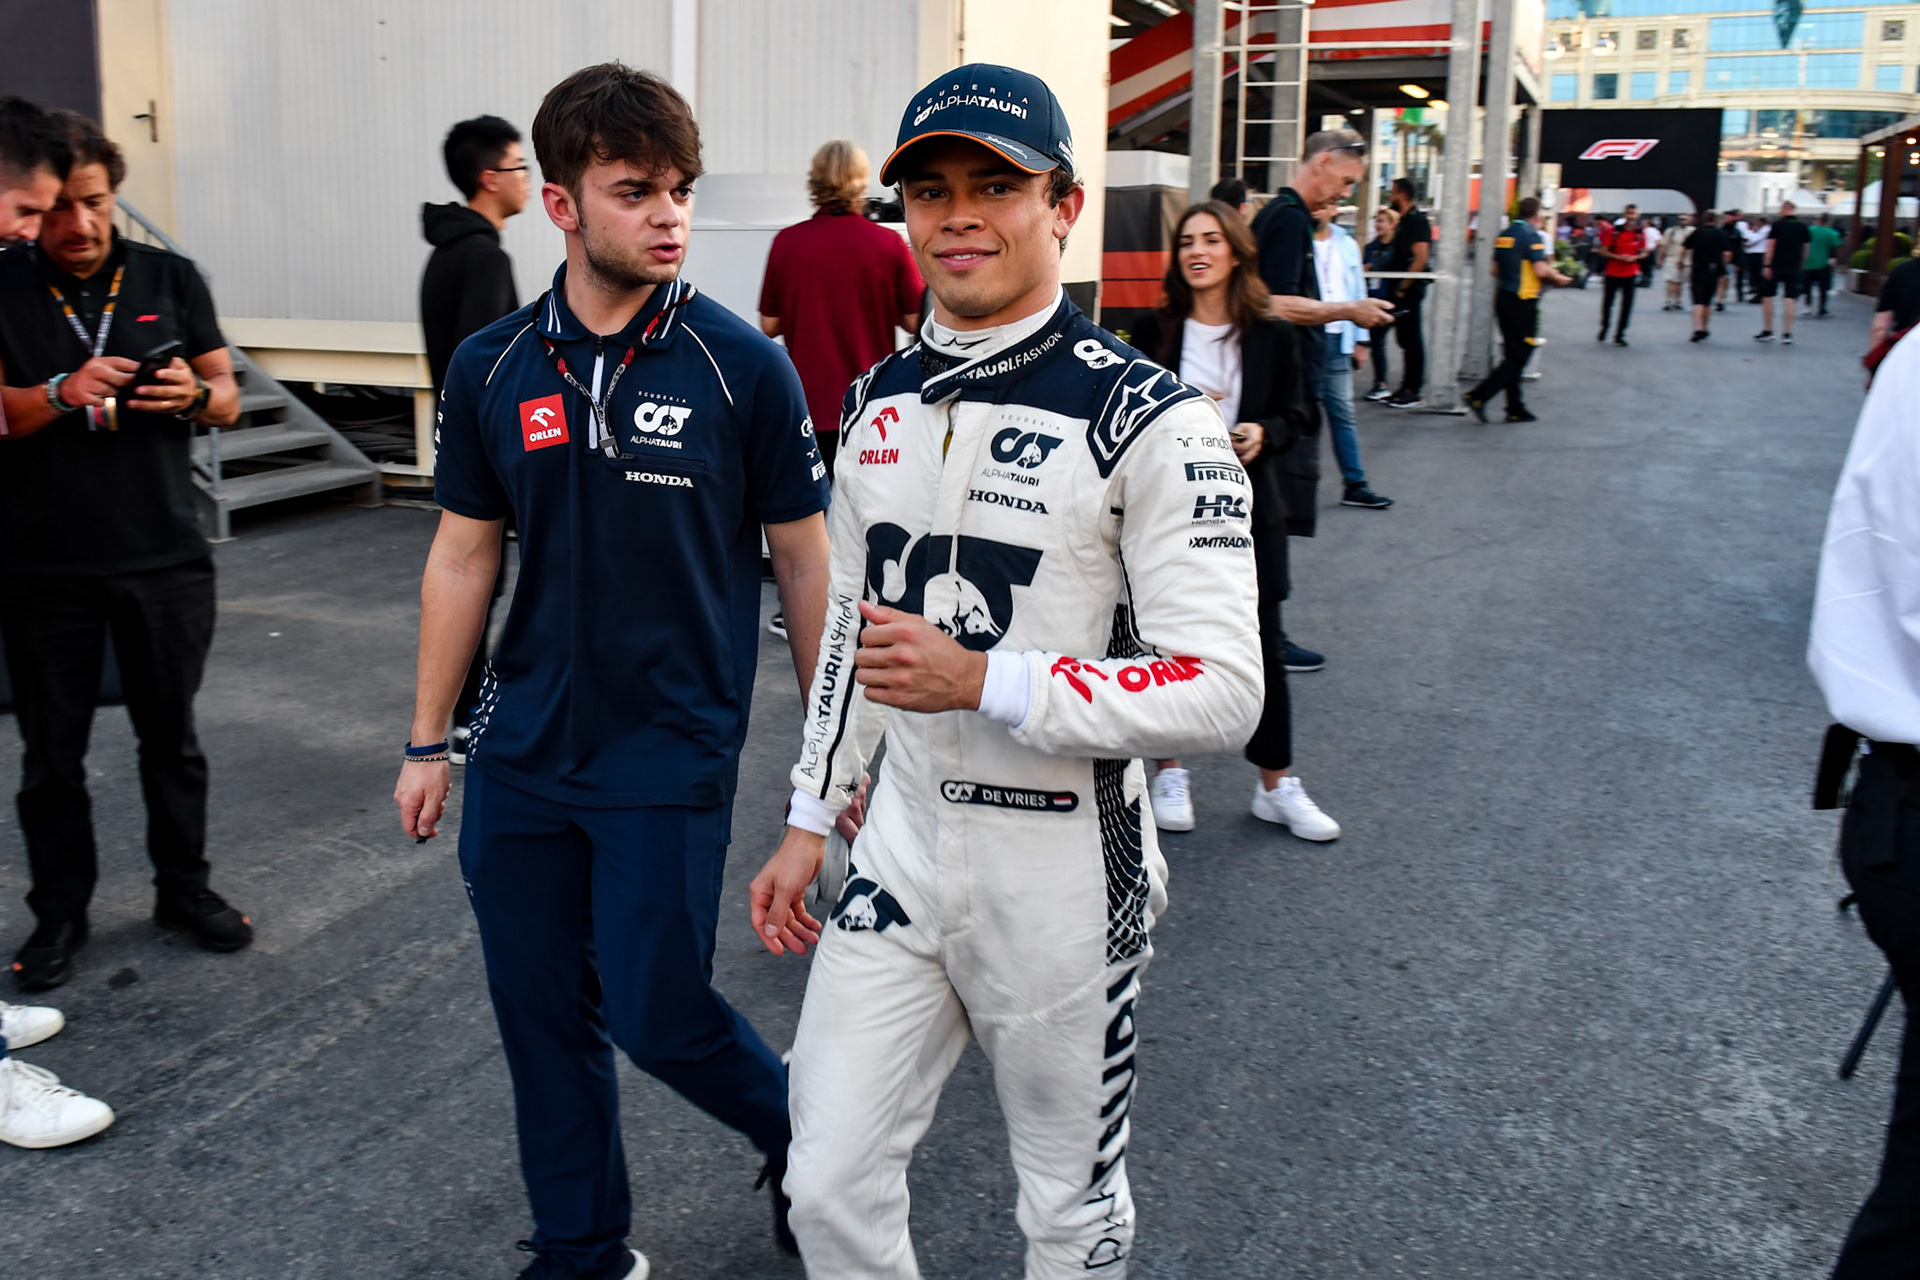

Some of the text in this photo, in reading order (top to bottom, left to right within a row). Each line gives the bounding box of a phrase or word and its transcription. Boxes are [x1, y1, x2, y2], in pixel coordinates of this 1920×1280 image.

[916, 83, 1029, 113] SCUDERIA
[931, 95, 1028, 120] ALPHATAURI
[1578, 139, 1660, 160] F1
[638, 390, 687, 404] SCUDERIA
[1001, 413, 1060, 431] SCUDERIA
[529, 427, 562, 442] ORLEN
[630, 434, 683, 450] ALPHATAURI
[859, 448, 899, 465] ORLEN
[624, 471, 694, 488] HONDA
[980, 468, 1040, 487] ALPHATAURI
[1184, 461, 1245, 485] PIRELLI
[967, 489, 1050, 515] HONDA
[1192, 494, 1247, 518] HRC
[982, 788, 1047, 807] DE VRIES
